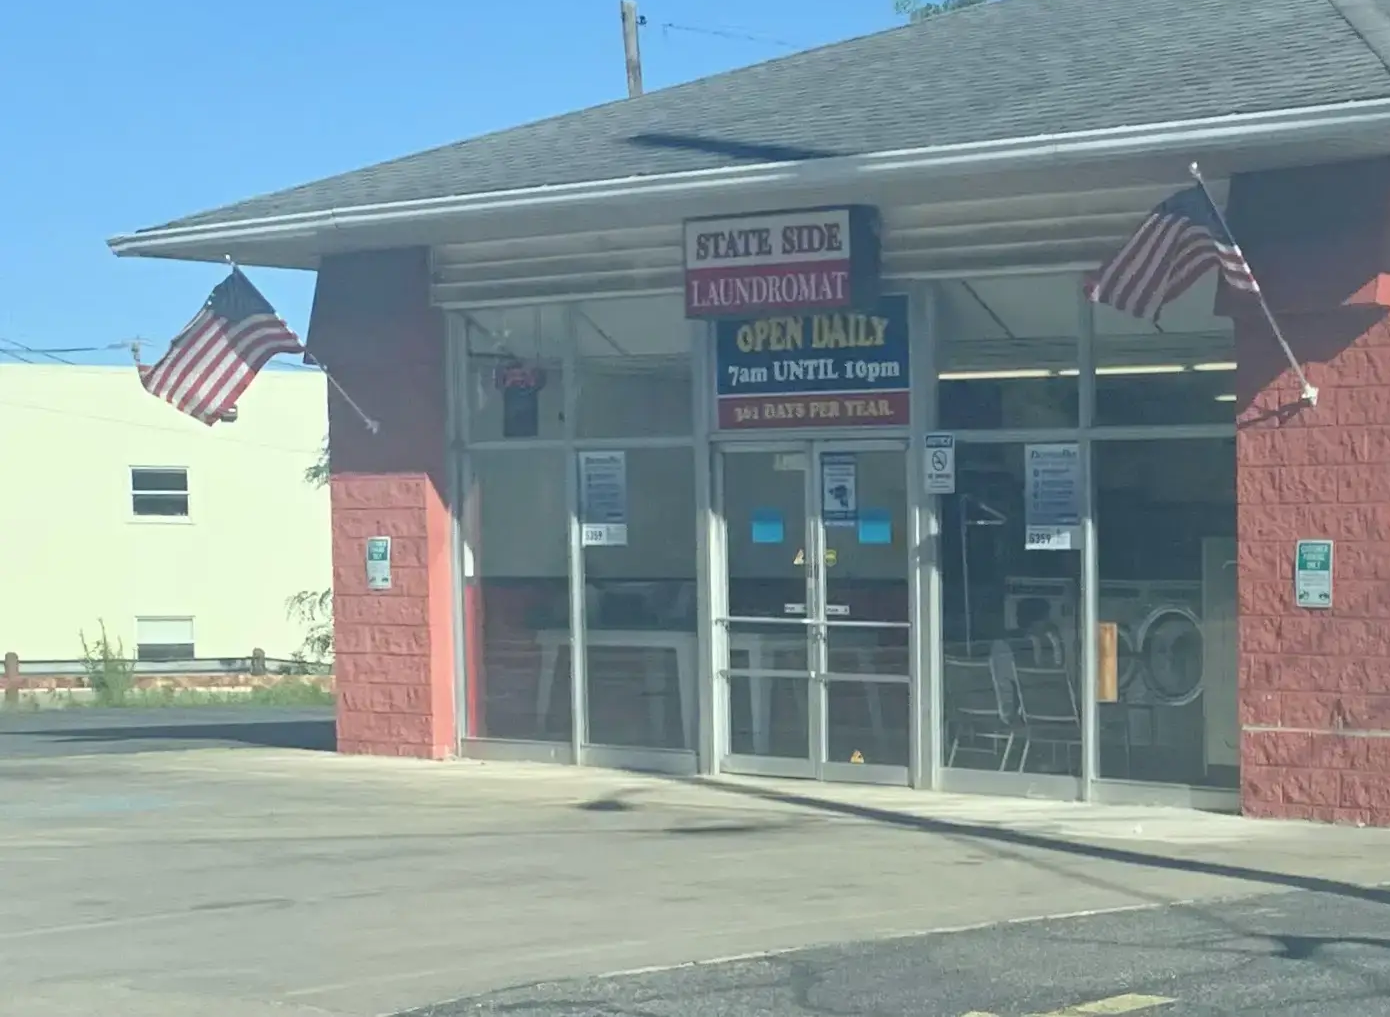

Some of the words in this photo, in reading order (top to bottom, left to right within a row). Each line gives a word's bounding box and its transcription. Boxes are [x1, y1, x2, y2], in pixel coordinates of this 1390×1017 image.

[696, 228, 772, 260] STATE
[781, 223, 843, 255] SIDE
[691, 271, 848, 308] LAUNDROMAT
[737, 316, 803, 352] OPEN
[811, 313, 889, 349] DAILY
[728, 365, 768, 385] 7am
[773, 359, 840, 381] UNTIL
[844, 360, 900, 382] 10pm
[763, 401, 804, 419] DAYS
[809, 400, 840, 419] PER
[844, 399, 895, 417] YEAR.
